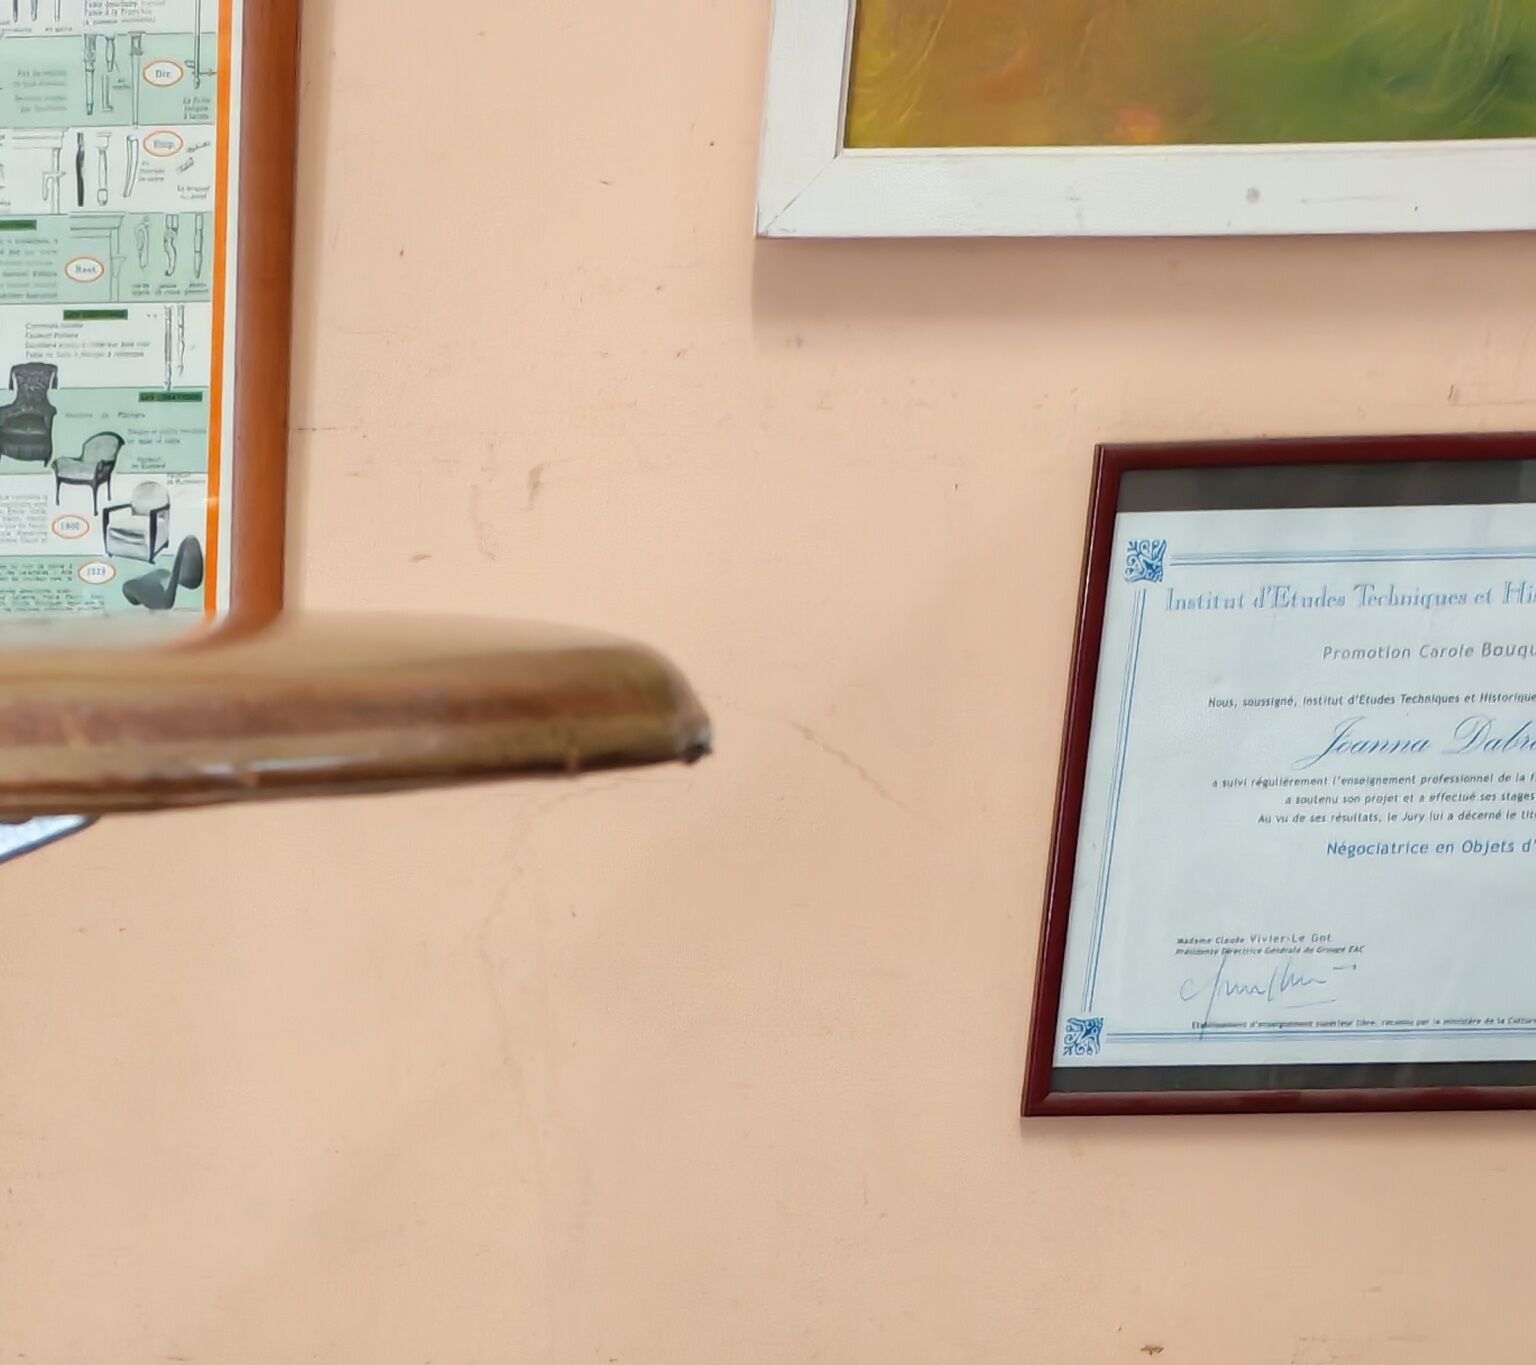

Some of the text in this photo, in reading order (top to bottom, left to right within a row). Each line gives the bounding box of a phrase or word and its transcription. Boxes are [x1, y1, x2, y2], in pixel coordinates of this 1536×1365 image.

[1165, 587, 1245, 611] Institut
[1353, 583, 1469, 609] Techniques
[1474, 588, 1493, 606] et
[1322, 645, 1412, 660] Promotion
[1419, 643, 1475, 659] Carole
[1400, 692, 1460, 707] Techniques
[1222, 776, 1247, 788] suivi
[1420, 772, 1495, 787] professionnel
[1498, 773, 1513, 784] de
[1515, 772, 1526, 783] la
[1295, 793, 1339, 806] soutenu
[1342, 795, 1361, 805] son
[1364, 792, 1398, 807] projet
[1479, 793, 1497, 803] ses
[1292, 813, 1307, 824] de
[1326, 839, 1430, 859] Négociatrice
[1435, 843, 1455, 855] en
[1462, 838, 1515, 857] Objets
